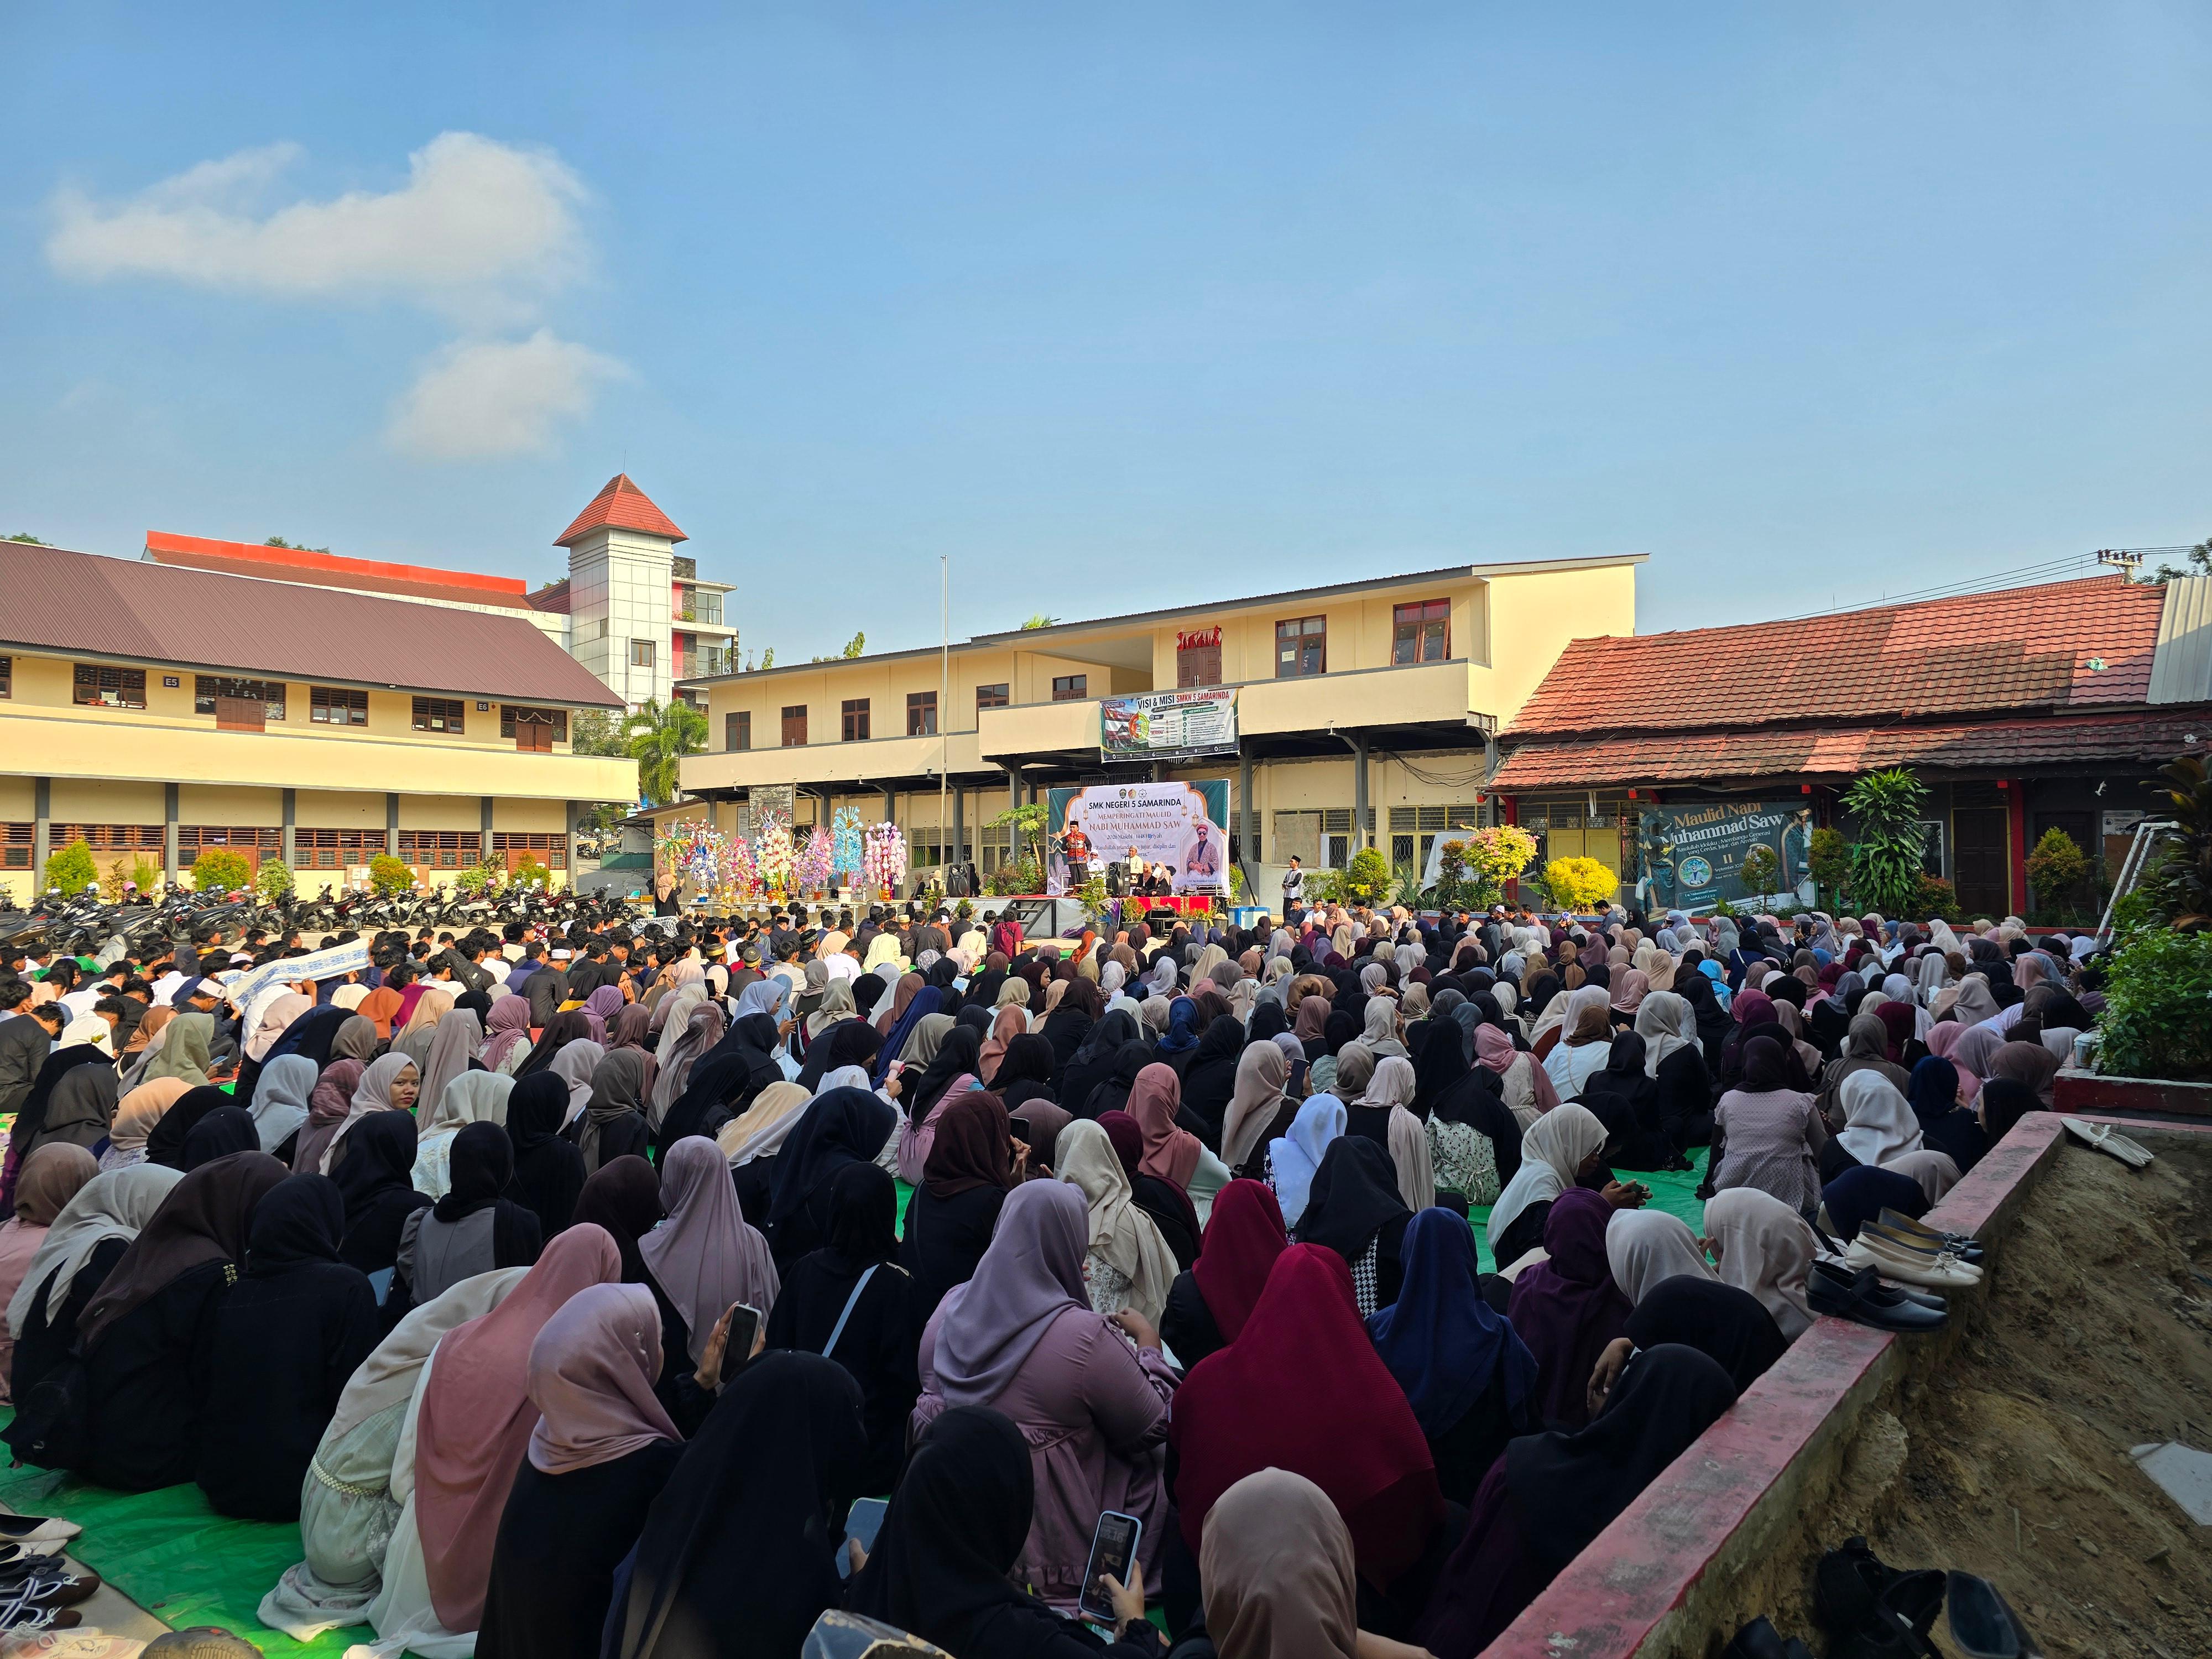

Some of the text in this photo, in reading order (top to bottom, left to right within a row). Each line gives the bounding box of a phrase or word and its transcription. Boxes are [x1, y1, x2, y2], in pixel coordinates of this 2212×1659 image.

[165, 678, 178, 686] E5
[1138, 698, 1151, 709] VISI
[1152, 697, 1157, 707] &
[1159, 695, 1175, 706] MISI
[1176, 693, 1192, 703] SMKN
[1192, 693, 1196, 701] 5
[1197, 691, 1230, 701] SAMARINDA
[1138, 798, 1182, 808] SAMARINDA
[1673, 805, 1726, 830] Maulid
[1088, 822, 1108, 832] NABI
[1110, 821, 1161, 832] MUHAMMAD
[1660, 813, 1785, 845] Muhammad Saw
[1723, 853, 1733, 864] 11
